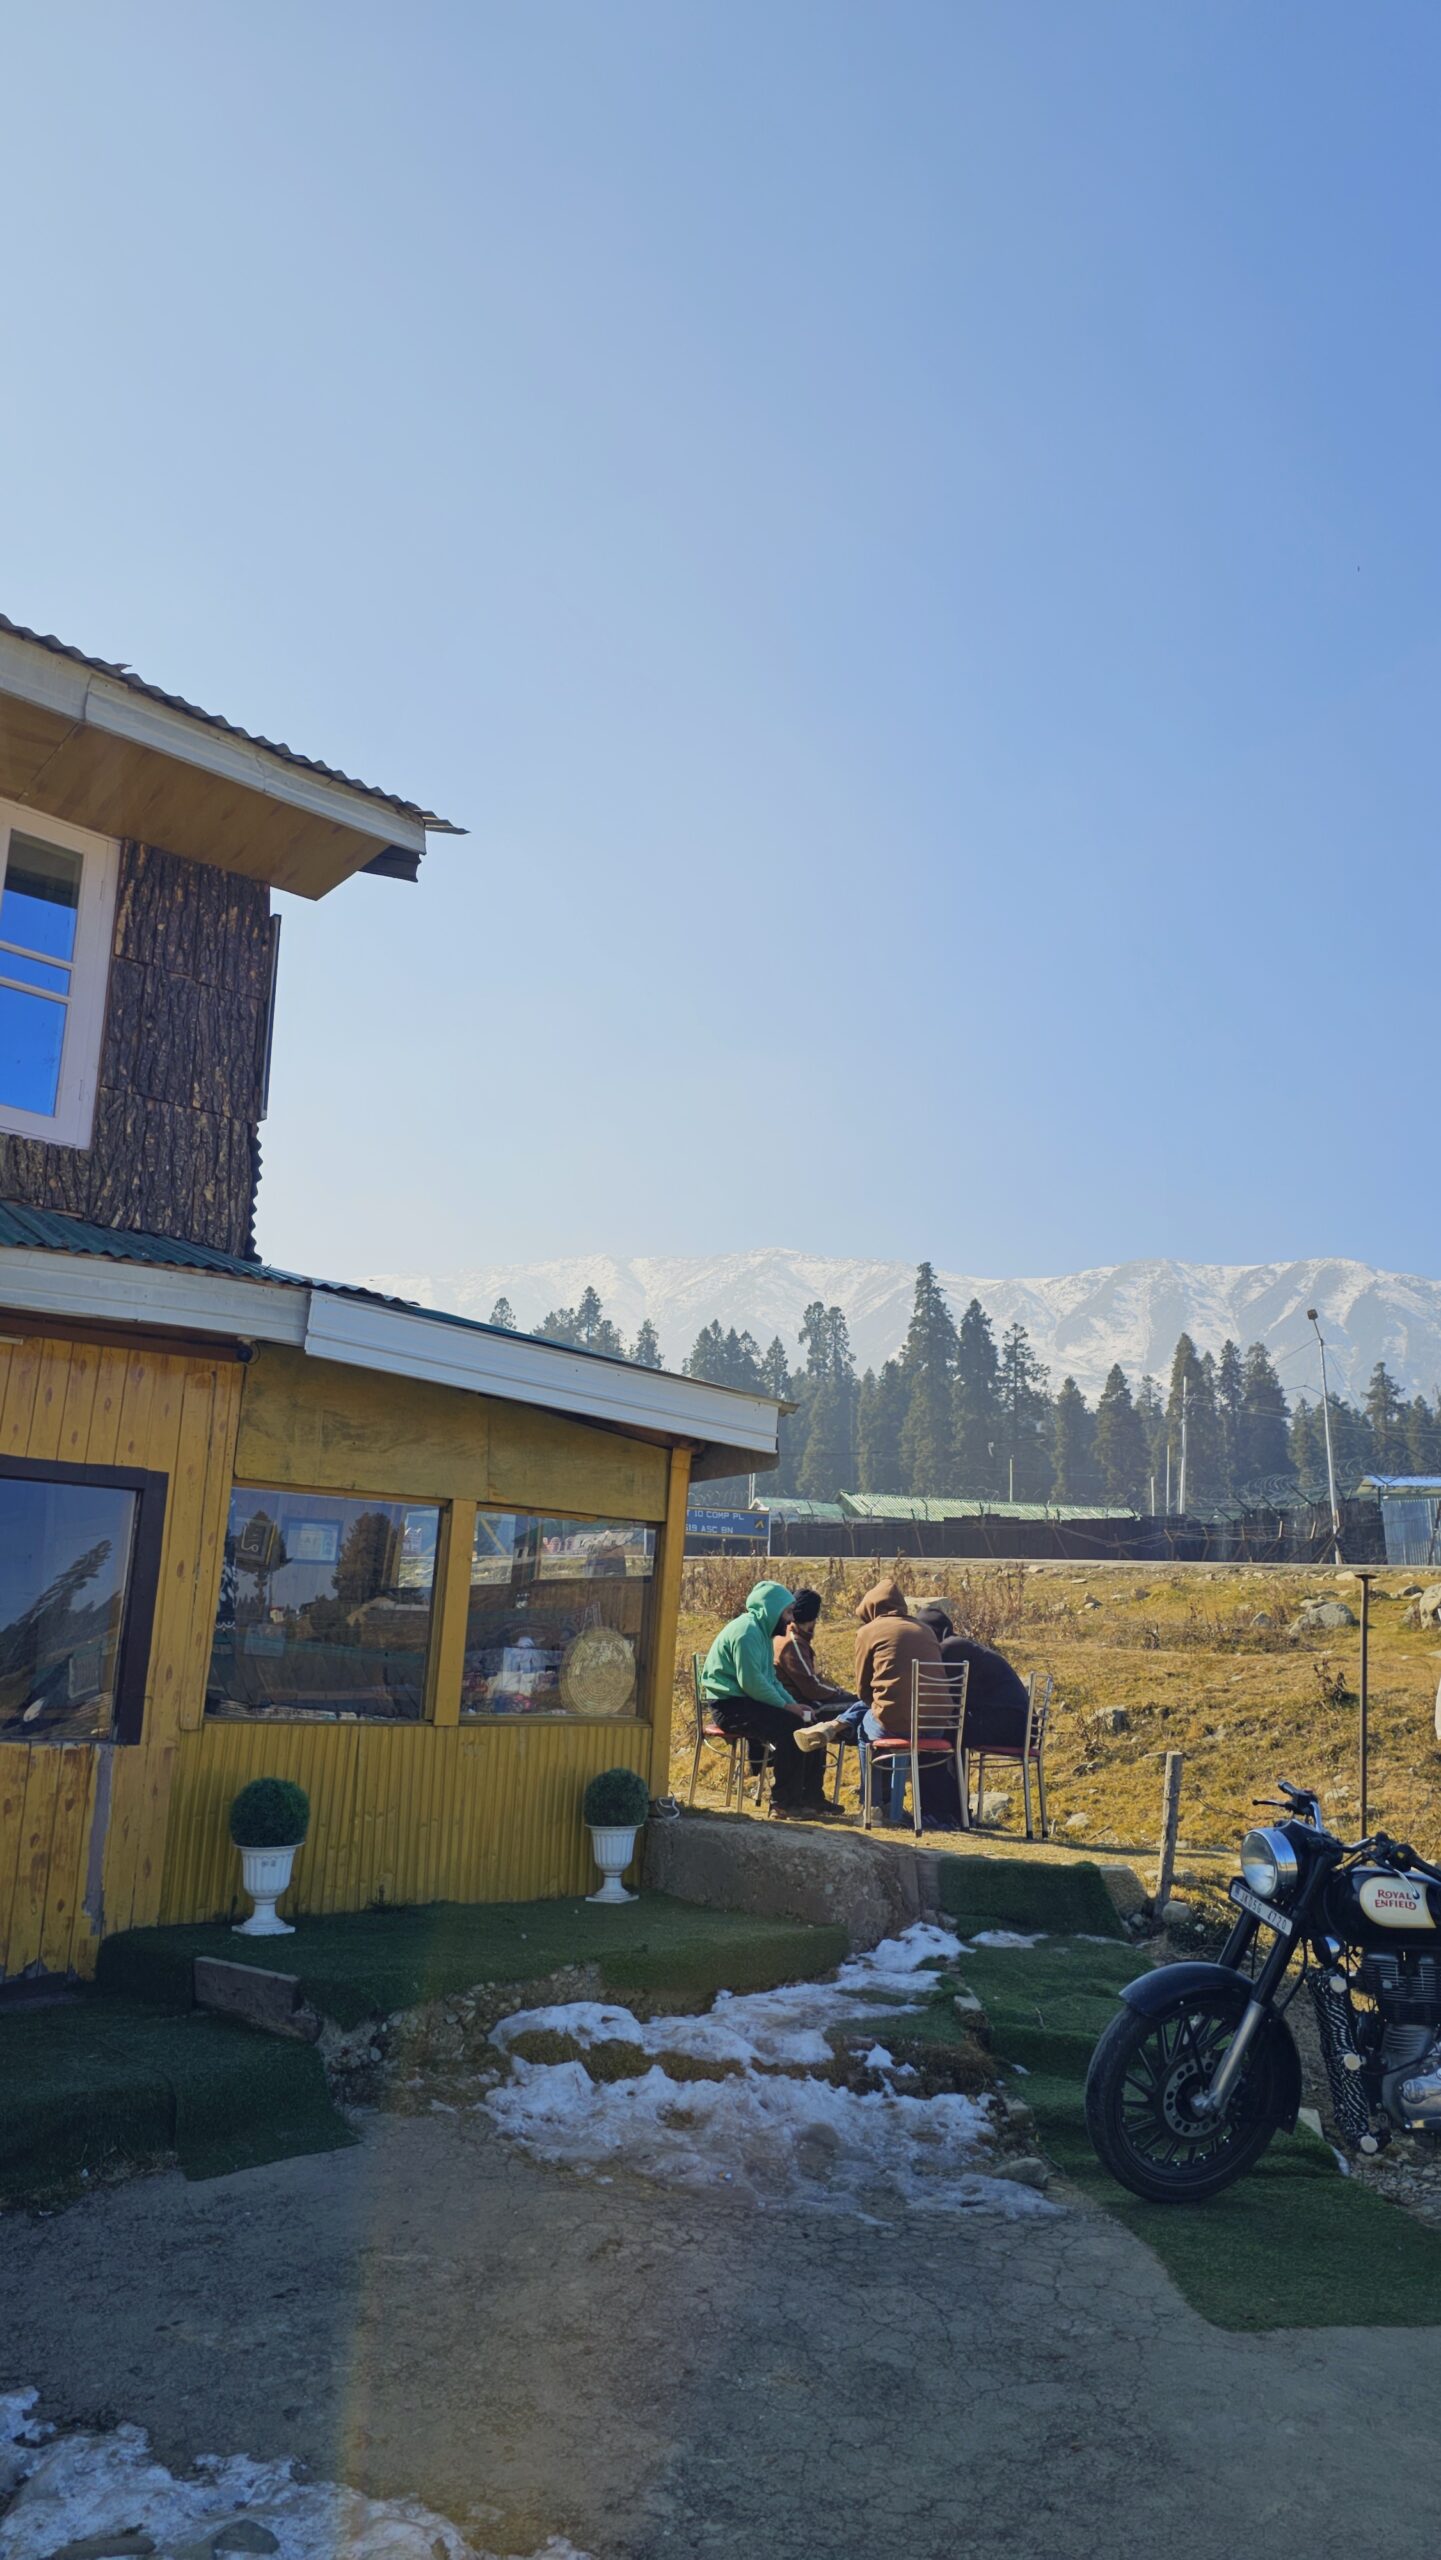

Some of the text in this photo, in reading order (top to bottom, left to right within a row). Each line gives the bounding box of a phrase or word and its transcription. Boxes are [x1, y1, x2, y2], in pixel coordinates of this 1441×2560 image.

[706, 1511, 730, 1519] COMP
[701, 1525, 718, 1533] ASC
[1377, 1889, 1412, 1900] ROYAL
[1375, 1898, 1417, 1911] ENFIELD
